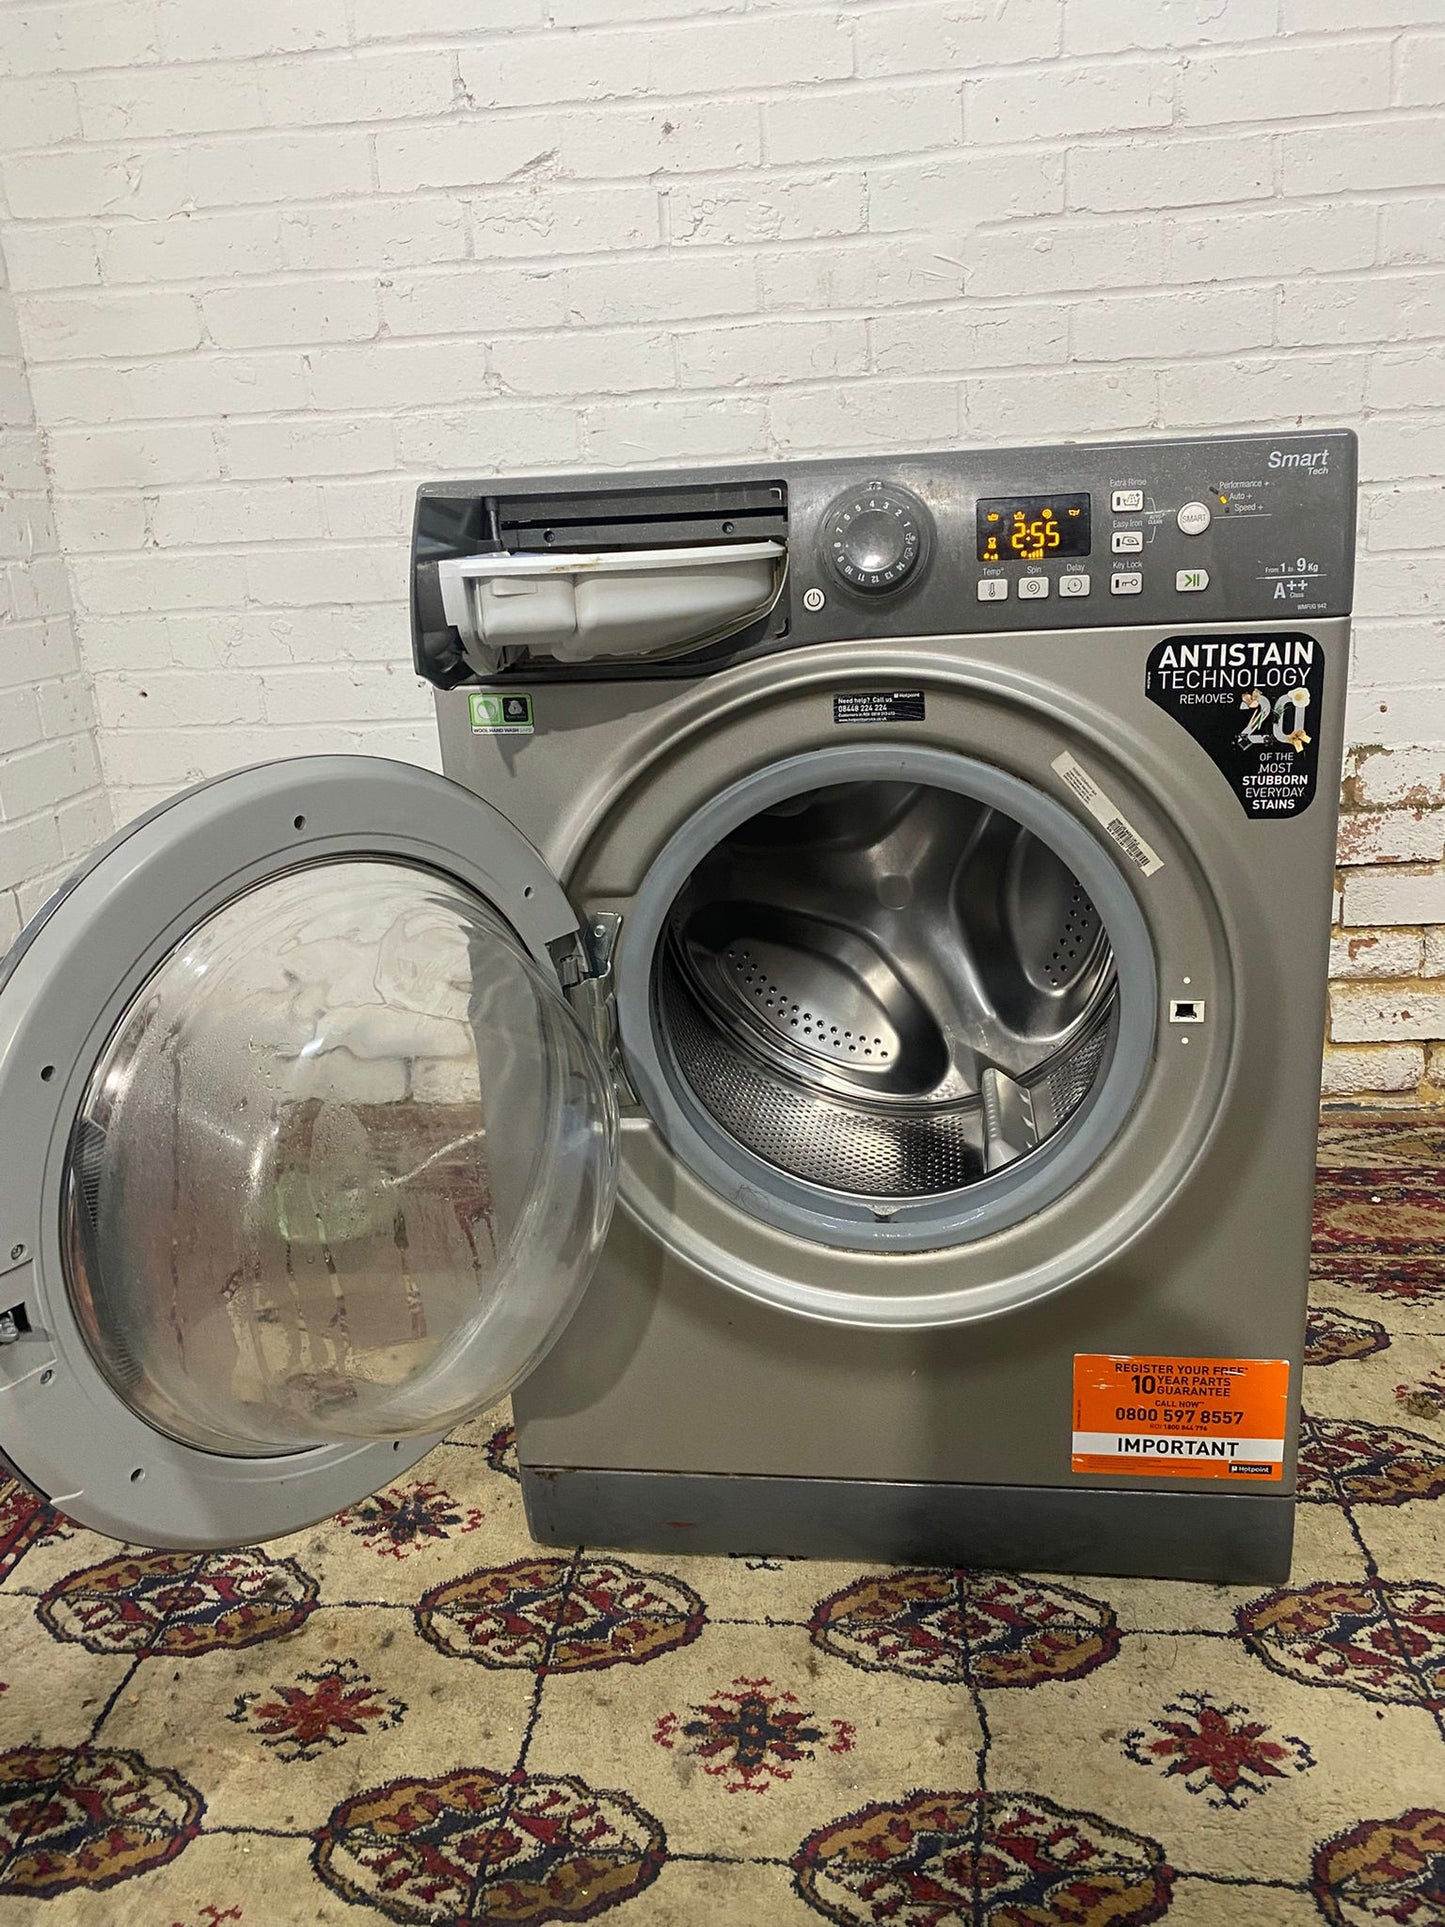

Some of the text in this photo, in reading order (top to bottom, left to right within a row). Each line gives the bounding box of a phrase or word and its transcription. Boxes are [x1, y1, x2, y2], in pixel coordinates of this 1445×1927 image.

[1268, 449, 1329, 468] Smart
[1307, 467, 1329, 475] Tech
[1110, 479, 1126, 487] Extra
[1219, 480, 1262, 489] Performance
[1229, 492, 1245, 500] Auto
[855, 504, 861, 512] 5
[883, 501, 889, 509] 3
[1234, 503, 1256, 513] Speed
[894, 509, 902, 517] 2
[1182, 514, 1206, 523] SMART
[1113, 520, 1128, 528] Easy
[1011, 521, 1060, 549] 2:55
[1066, 563, 1085, 572] Delay
[1112, 560, 1143, 569] Key Lock
[1280, 562, 1286, 573] 1
[1296, 557, 1307, 572] 9
[1307, 562, 1319, 573] Kg
[844, 565, 854, 575] 10
[1026, 565, 1042, 574] Spin
[857, 573, 865, 582] 11
[871, 575, 880, 583] 12
[884, 571, 894, 580] 13
[1273, 579, 1308, 599] A++
[1158, 641, 1314, 669] ANTISTAIN
[1158, 667, 1311, 689] TECHNOLOGY
[1179, 693, 1234, 705] REMOVES
[860, 704, 873, 712] 224
[1233, 687, 1312, 752] 20
[1259, 752, 1294, 761] OF THE
[1258, 762, 1293, 774] MOST
[1242, 774, 1308, 786] STUBBORN
[1245, 786, 1305, 798] EVERYDAY
[1252, 799, 1295, 810] STAINS
[1115, 1363, 1174, 1374] REGISTER
[1177, 1365, 1209, 1375] YOUR
[1131, 1375, 1231, 1395] 10 YEAR PARTS
[1157, 1385, 1231, 1397] GUARANTEE
[1154, 1400, 1176, 1408] CALL
[1115, 1407, 1244, 1425] 0800 597 8557
[1118, 1437, 1239, 1457] IMPORTANT
[1238, 1465, 1270, 1474] Hotpoint
